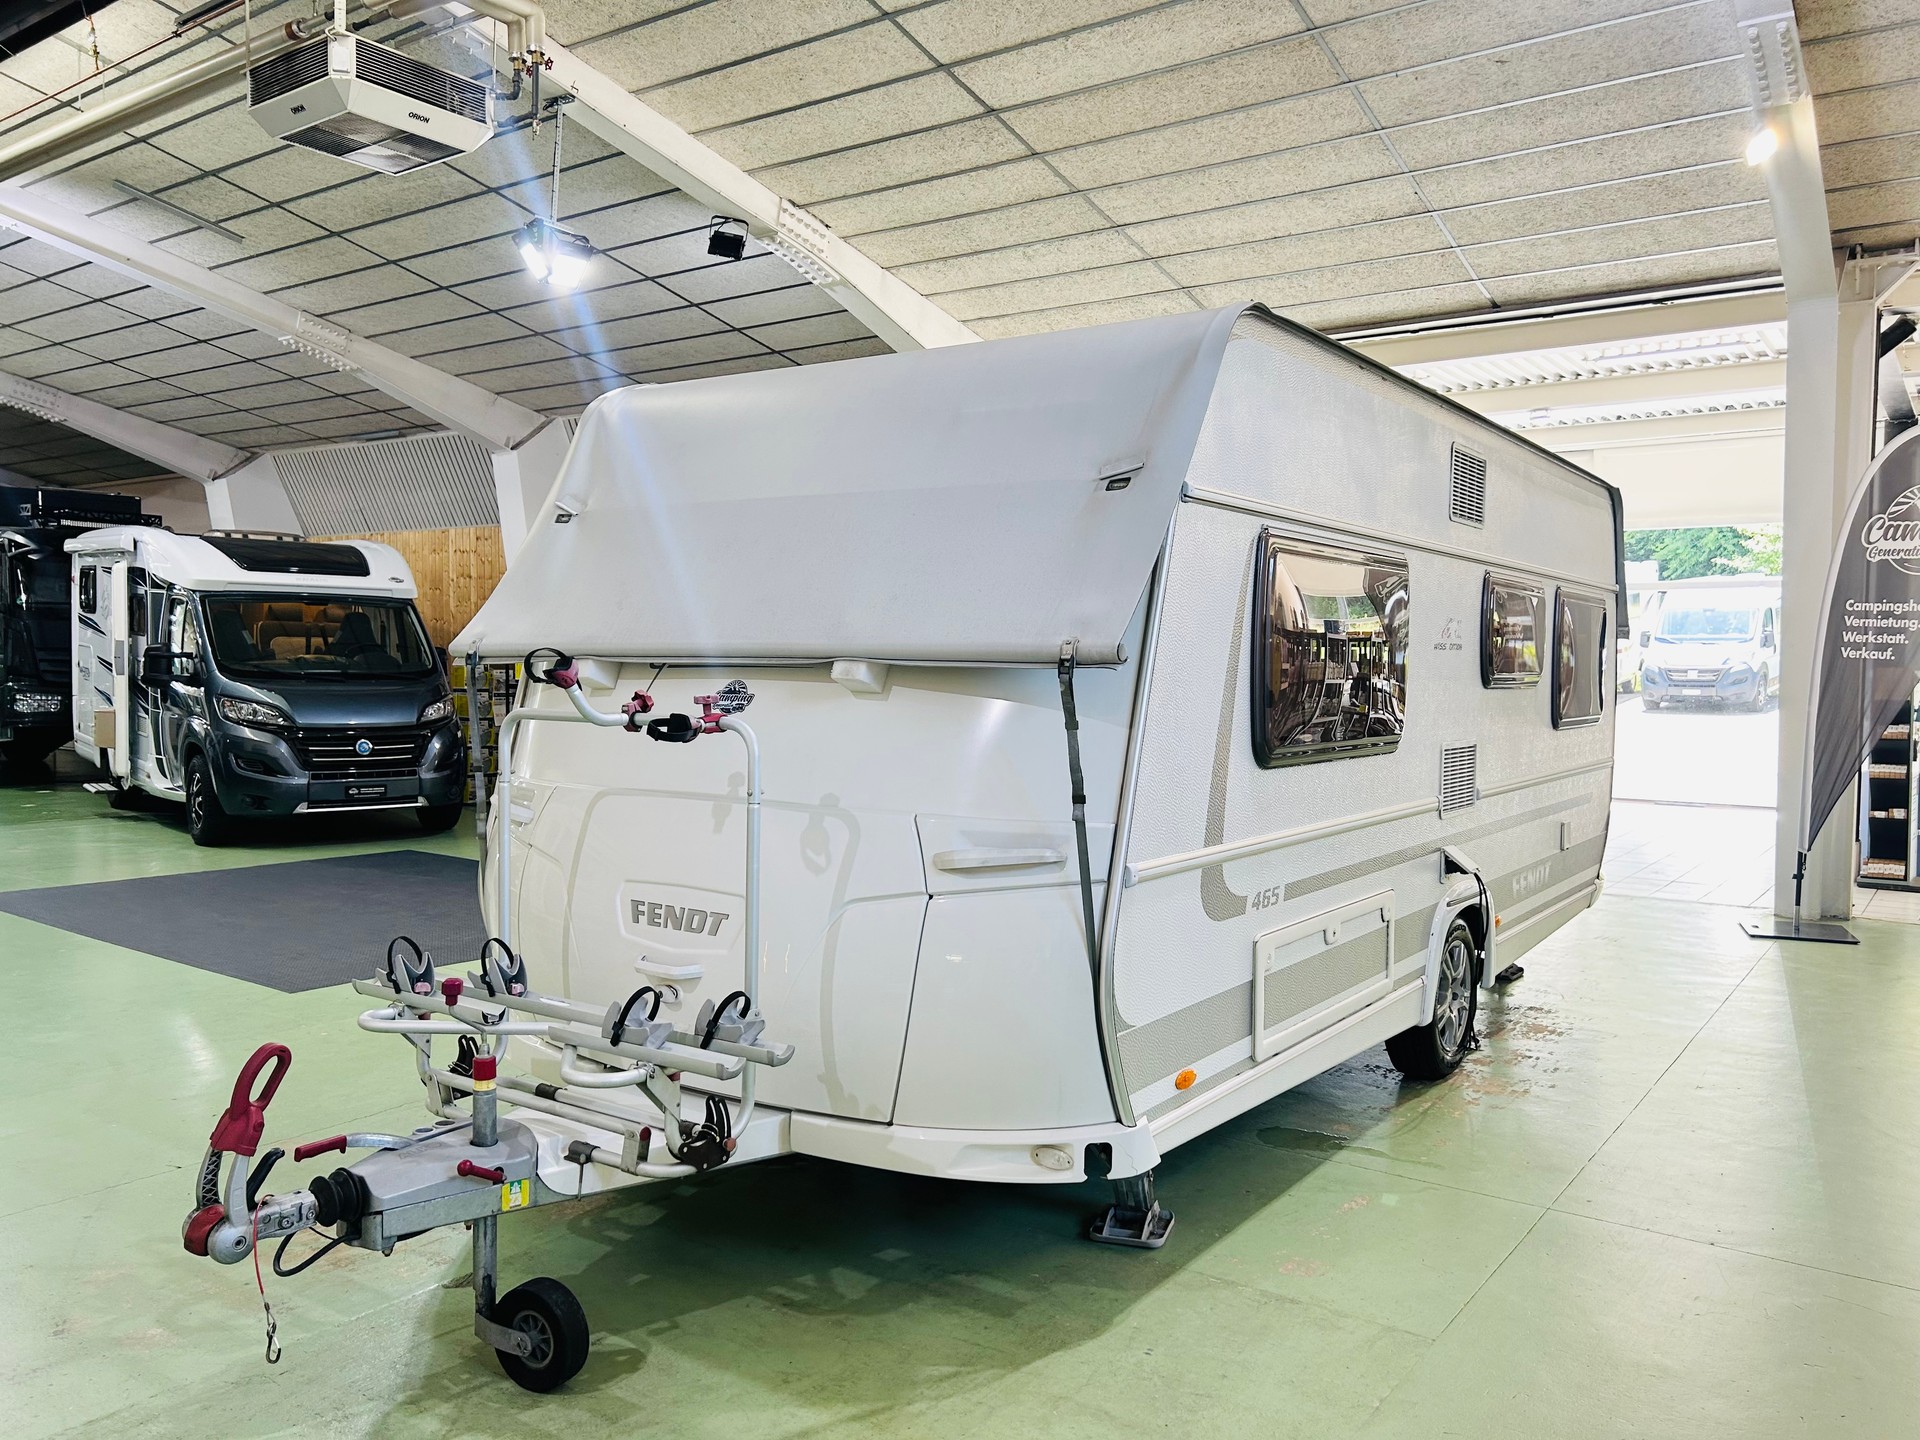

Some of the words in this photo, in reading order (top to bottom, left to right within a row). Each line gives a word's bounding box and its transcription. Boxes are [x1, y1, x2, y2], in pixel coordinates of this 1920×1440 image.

[408, 111, 430, 124] ORION
[1842, 631, 1909, 645] Werkstatt.
[1840, 647, 1895, 660] Verkauf.
[1512, 861, 1552, 899] FENDT
[1251, 885, 1280, 910] 465
[630, 899, 730, 937] FENDT
